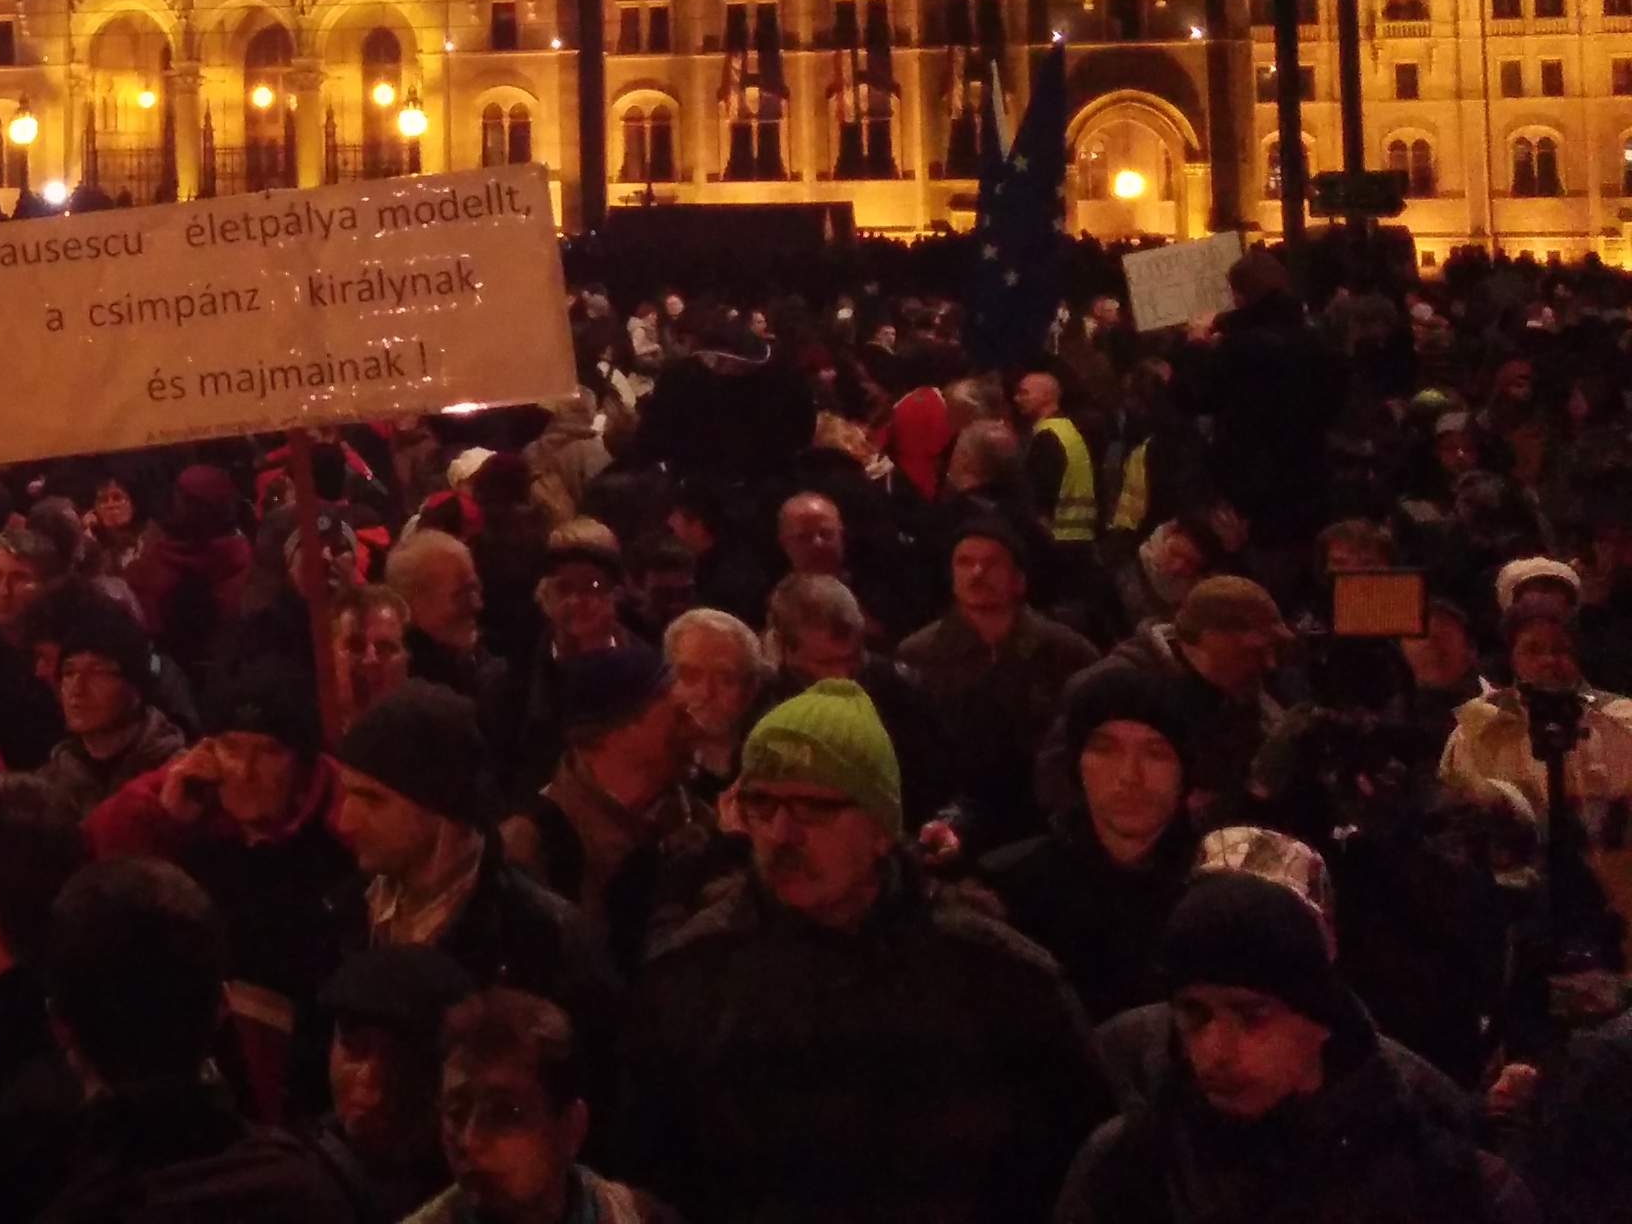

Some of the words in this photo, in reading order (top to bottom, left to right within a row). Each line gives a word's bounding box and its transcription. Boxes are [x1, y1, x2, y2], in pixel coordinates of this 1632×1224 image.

[185, 200, 358, 247] életpálya
[377, 181, 532, 231] modellt,
[45, 308, 64, 332] a
[88, 284, 262, 327] csimpánz
[308, 259, 478, 307] királynak
[147, 367, 186, 401] és
[199, 347, 406, 398] majmainak
